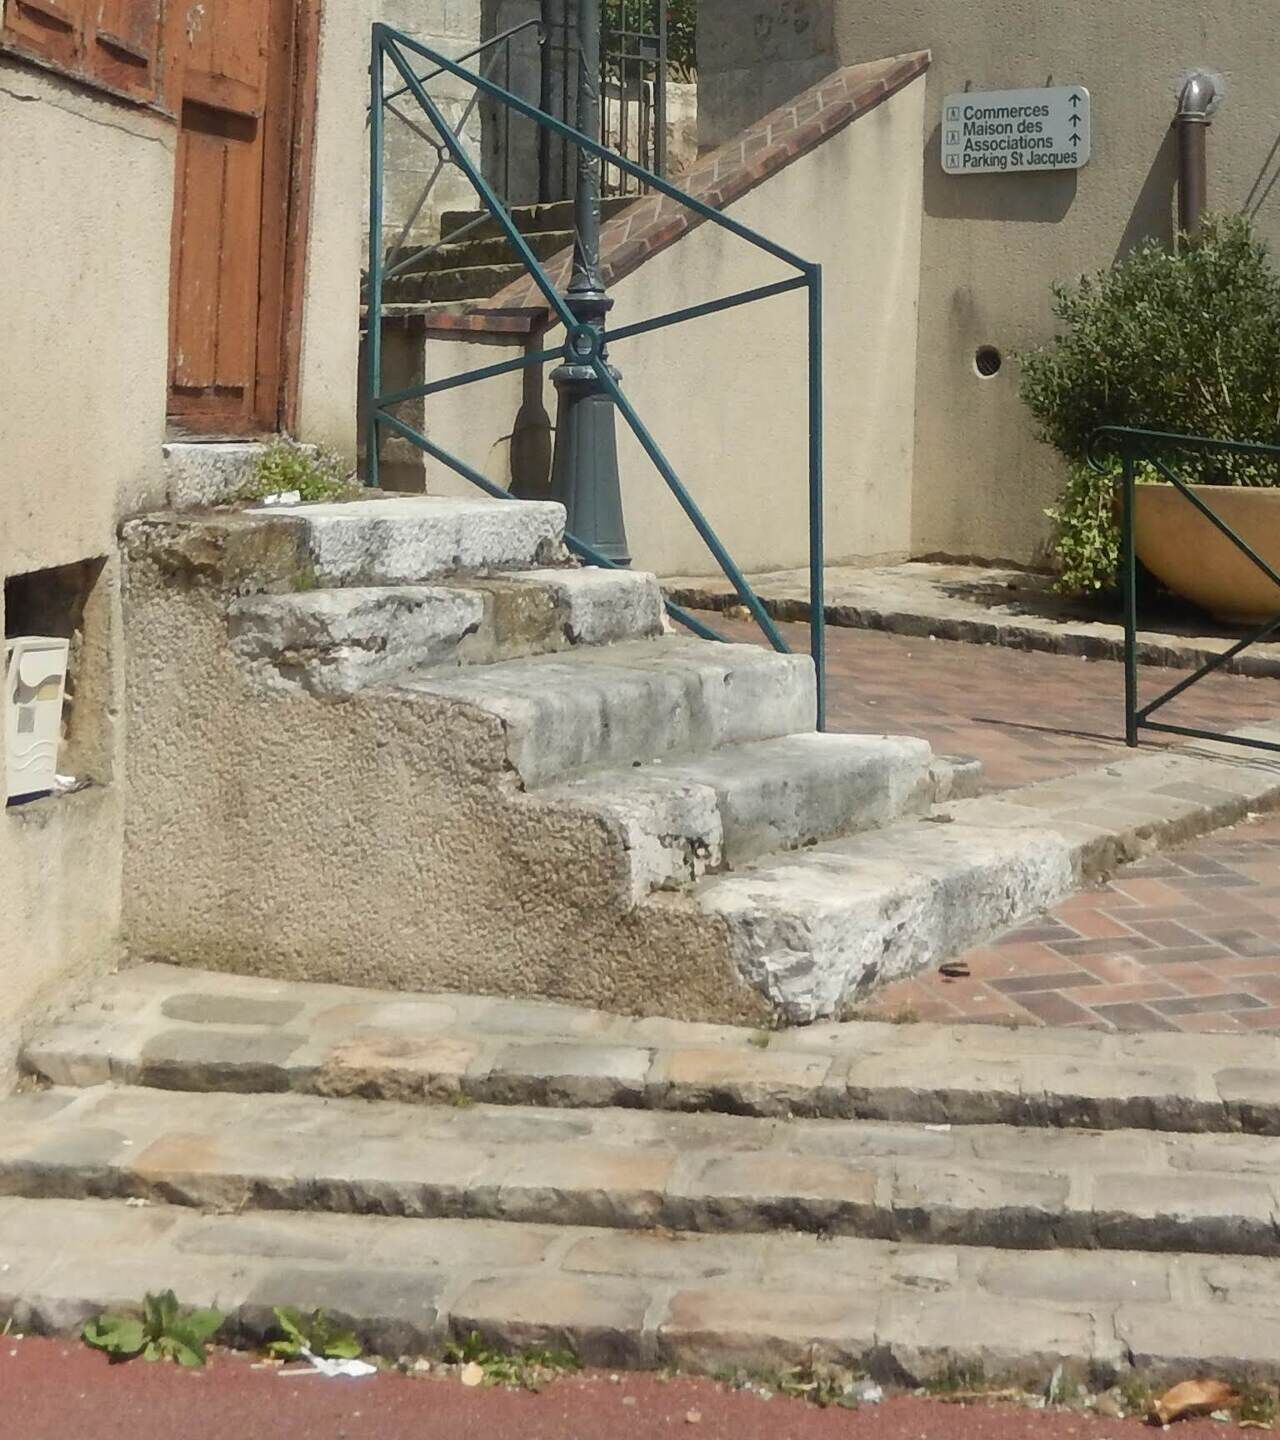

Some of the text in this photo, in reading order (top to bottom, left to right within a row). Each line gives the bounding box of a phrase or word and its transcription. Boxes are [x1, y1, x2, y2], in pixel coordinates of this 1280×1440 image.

[963, 105, 1050, 121] Commerces
[963, 120, 1043, 136] Maison des
[963, 135, 1054, 152] Associations
[962, 150, 1078, 170] Parking St Jacques
